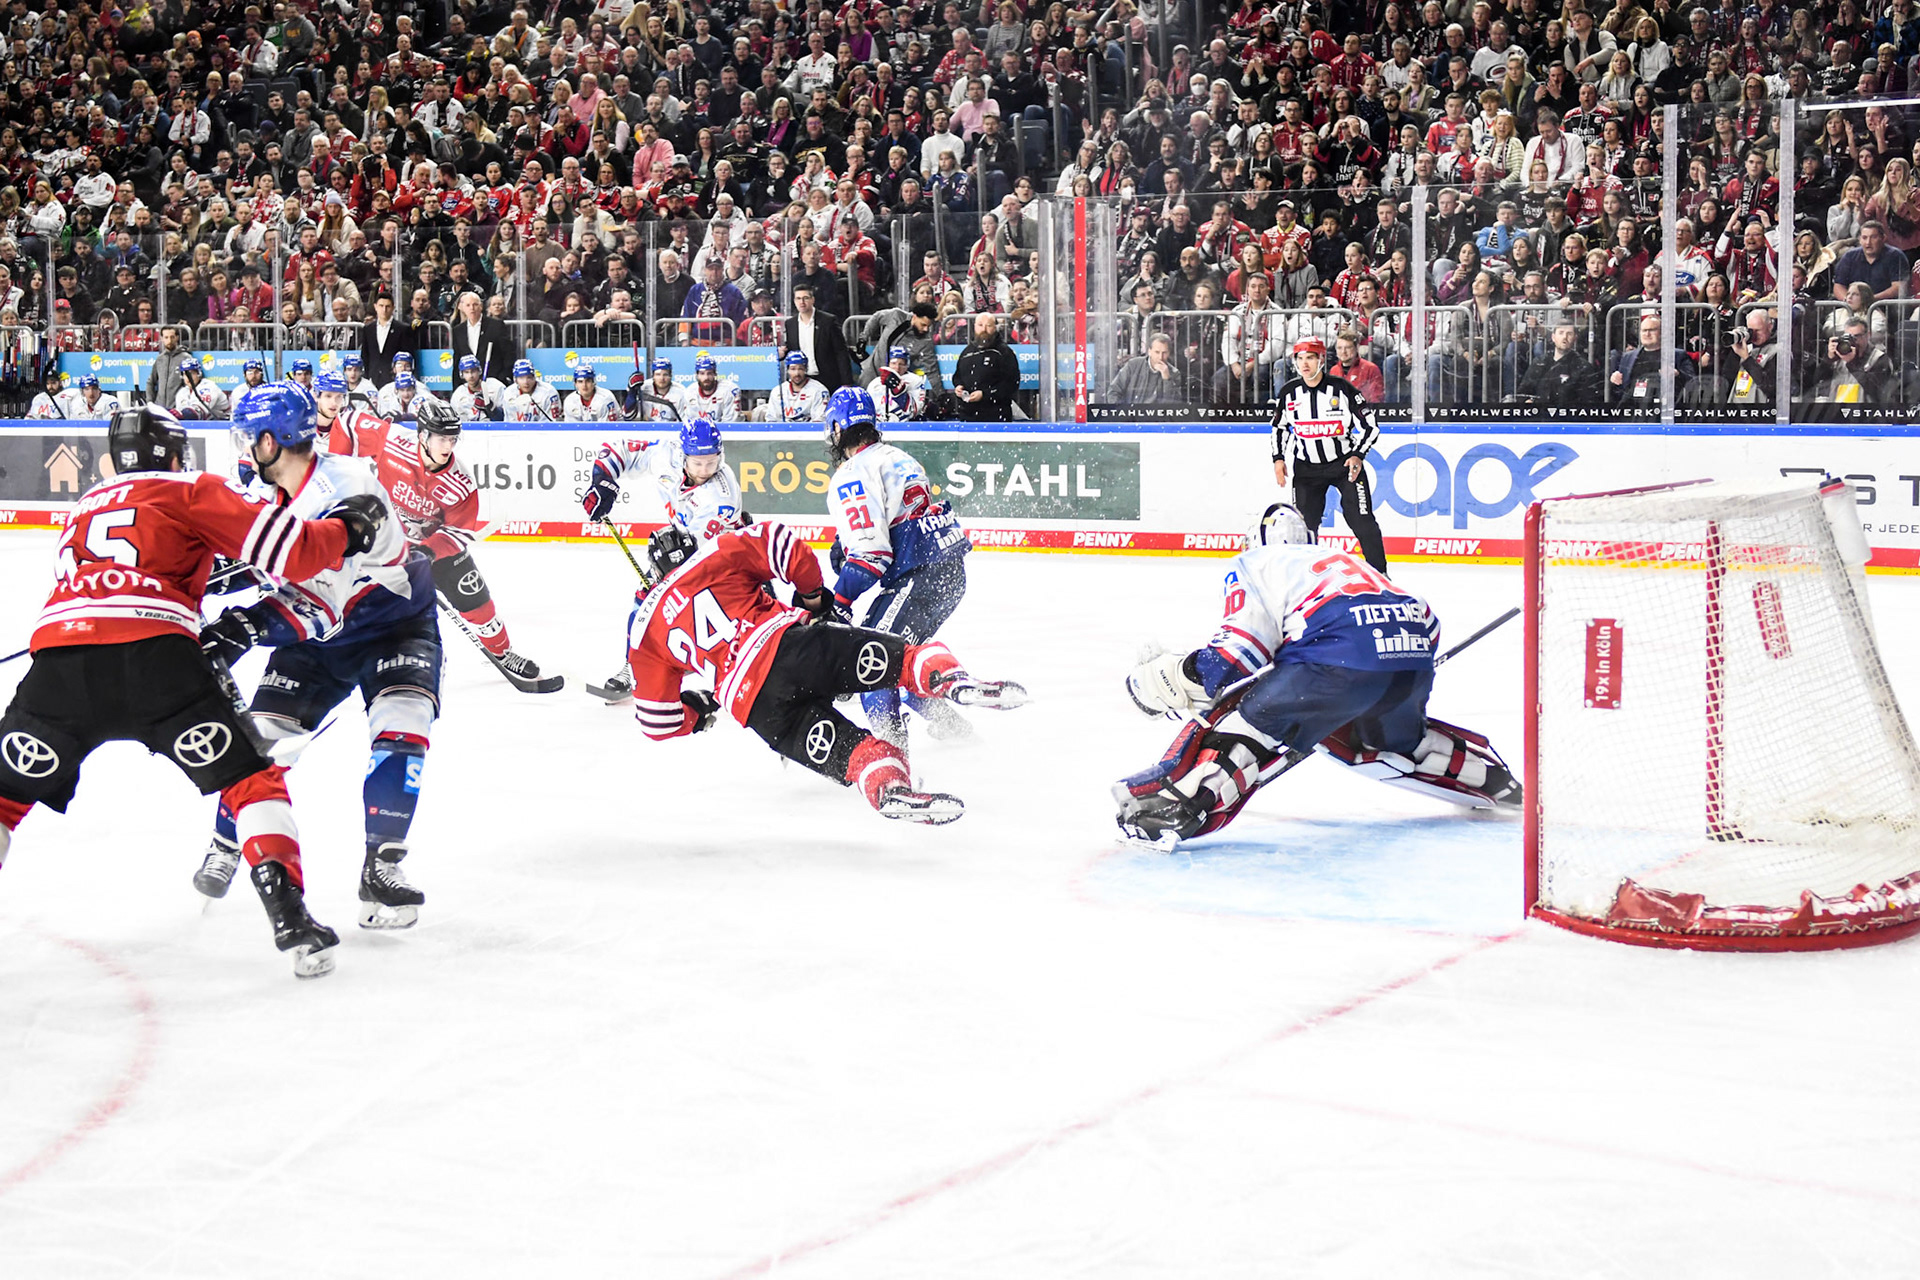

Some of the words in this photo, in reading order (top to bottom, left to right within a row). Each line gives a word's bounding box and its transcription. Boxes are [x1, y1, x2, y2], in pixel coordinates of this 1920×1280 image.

[581, 355, 645, 365] sportwetten.e
[360, 418, 381, 430] 5
[152, 444, 167, 458] 55
[473, 453, 557, 491] us.io
[500, 521, 543, 536] ENNY.
[845, 504, 875, 532] 21
[1879, 524, 1920, 534] JEDE
[1546, 542, 1604, 558] ENNY.
[661, 587, 691, 626] SILL
[1349, 603, 1427, 627] TIEFENS
[666, 587, 741, 693] 24
[1372, 626, 1432, 654] inter
[1595, 625, 1611, 657] Köln
[376, 653, 432, 674] inter
[1595, 658, 1611, 675] in
[1595, 676, 1611, 702] 19x
